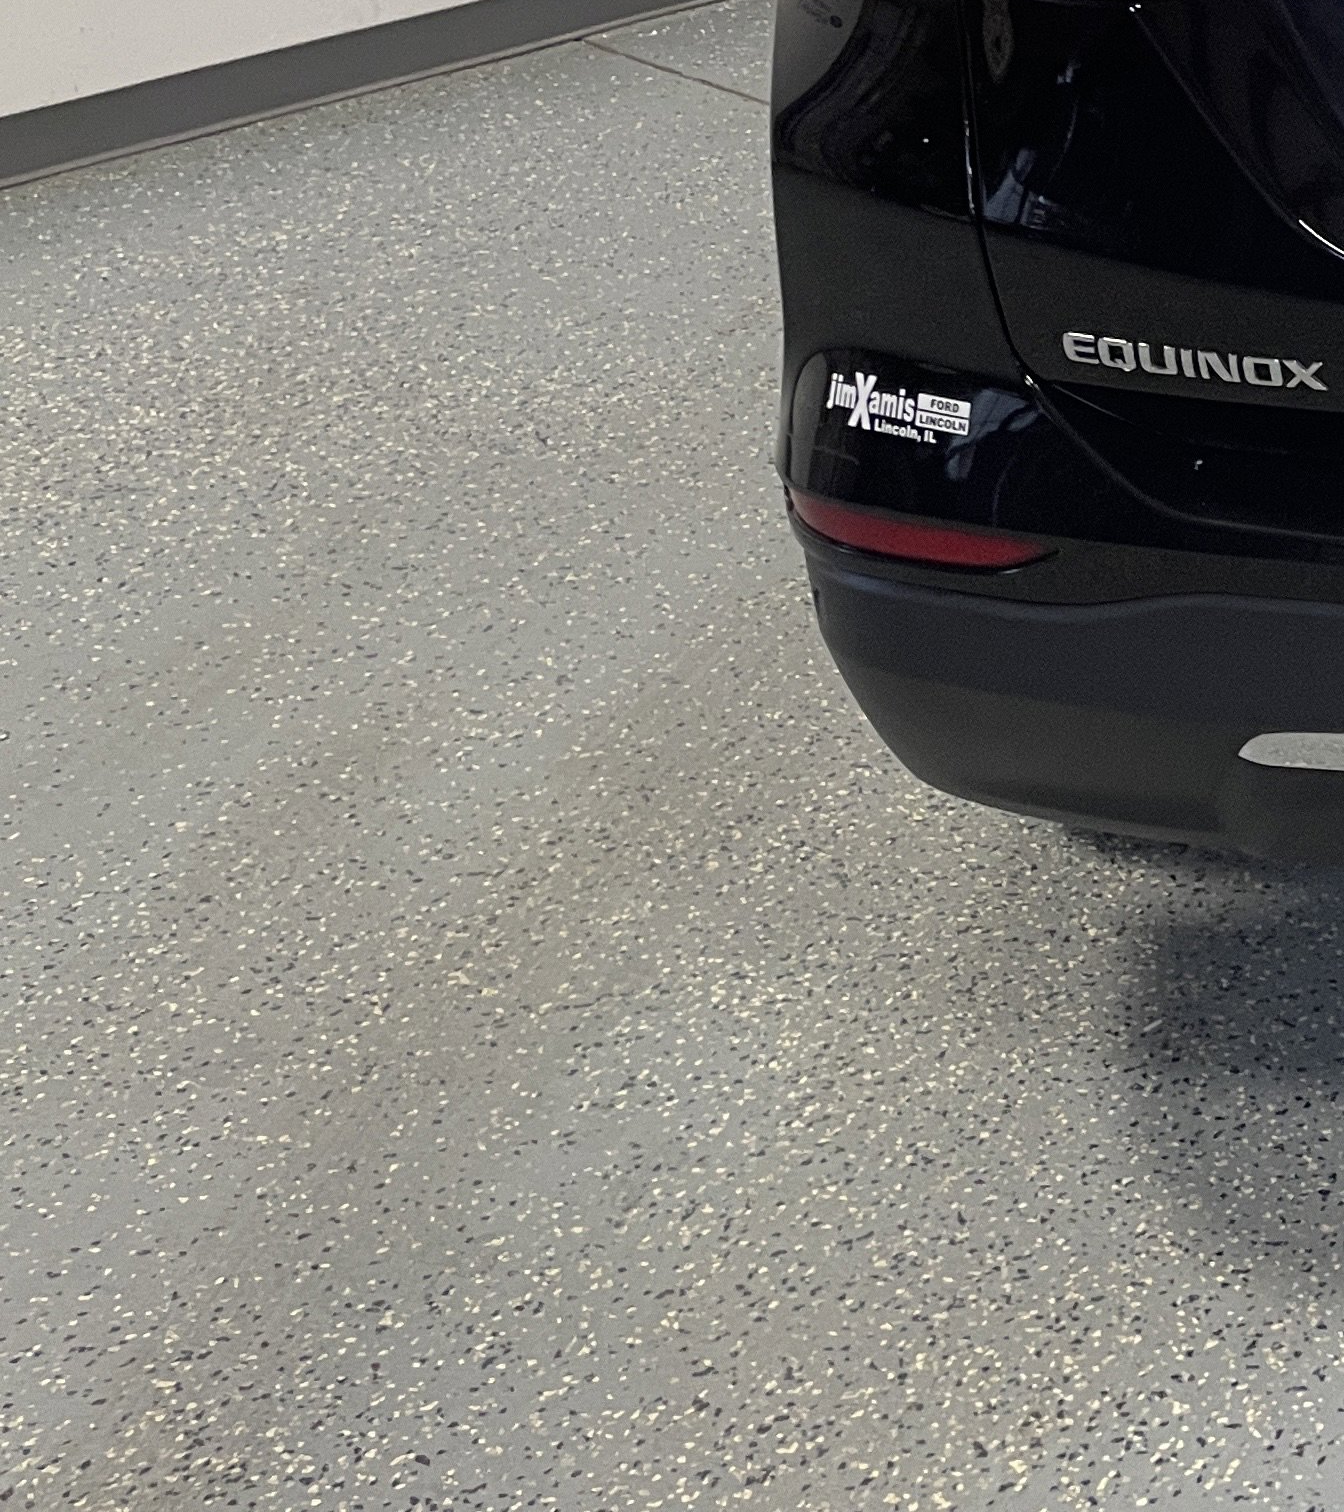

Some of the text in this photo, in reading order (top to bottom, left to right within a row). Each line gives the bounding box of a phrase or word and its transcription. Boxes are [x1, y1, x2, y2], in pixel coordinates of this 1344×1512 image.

[1062, 331, 1329, 392] EQUINOX
[930, 398, 961, 414] FORD
[873, 418, 938, 444] Lincoln, IL
[918, 416, 967, 433] LINCOLN
